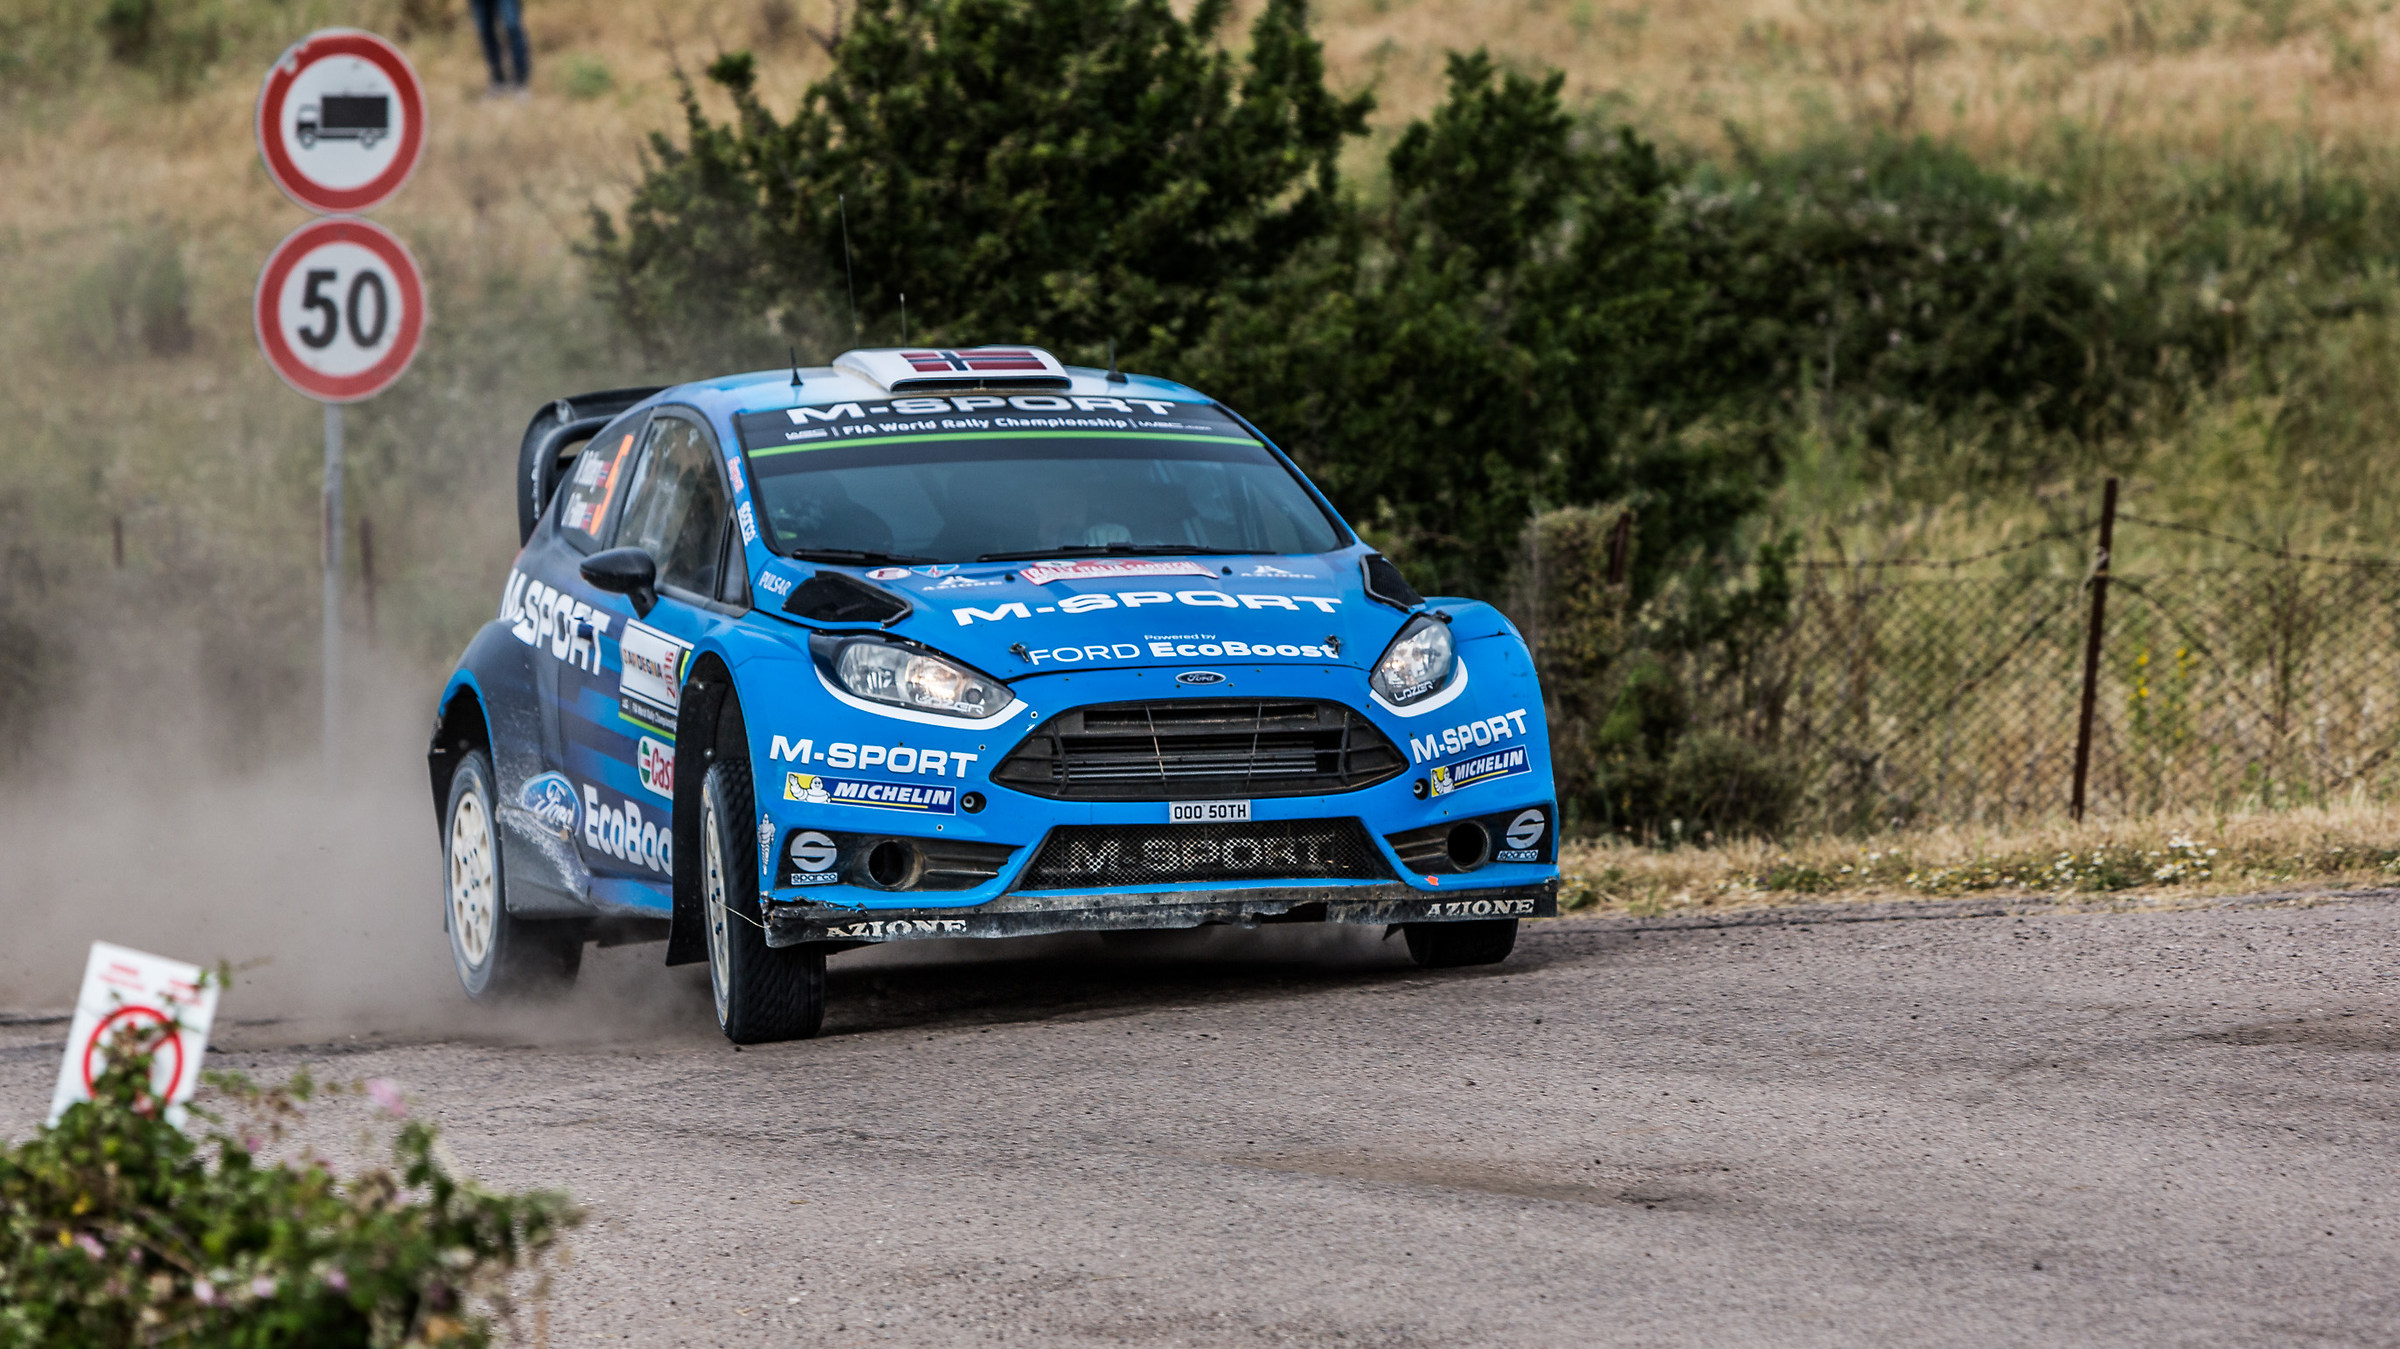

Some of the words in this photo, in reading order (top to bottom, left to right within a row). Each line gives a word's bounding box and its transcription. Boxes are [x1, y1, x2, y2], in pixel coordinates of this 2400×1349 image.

[297, 267, 389, 350] 50
[786, 395, 1176, 426] M-SPORT
[842, 424, 877, 436] FIA
[879, 419, 937, 433] World
[941, 418, 989, 430] Rally
[994, 416, 1128, 430] Championship
[758, 570, 792, 597] PULSAR
[951, 590, 1343, 627] M-SPORT
[1144, 633, 1198, 641] Powered
[1200, 633, 1216, 641] by
[1029, 643, 1141, 665] FORD
[1148, 641, 1340, 659] EcoBoost
[1410, 708, 1528, 764] M-SPORT
[769, 734, 978, 778] M-SPORT
[1455, 749, 1525, 783] MICHELIN
[834, 782, 952, 806] MICHELIN
[1068, 832, 1335, 875] M-SPORT
[792, 873, 837, 884] sparco
[1427, 899, 1535, 917] AZIONE
[827, 919, 967, 938] AZIONE
